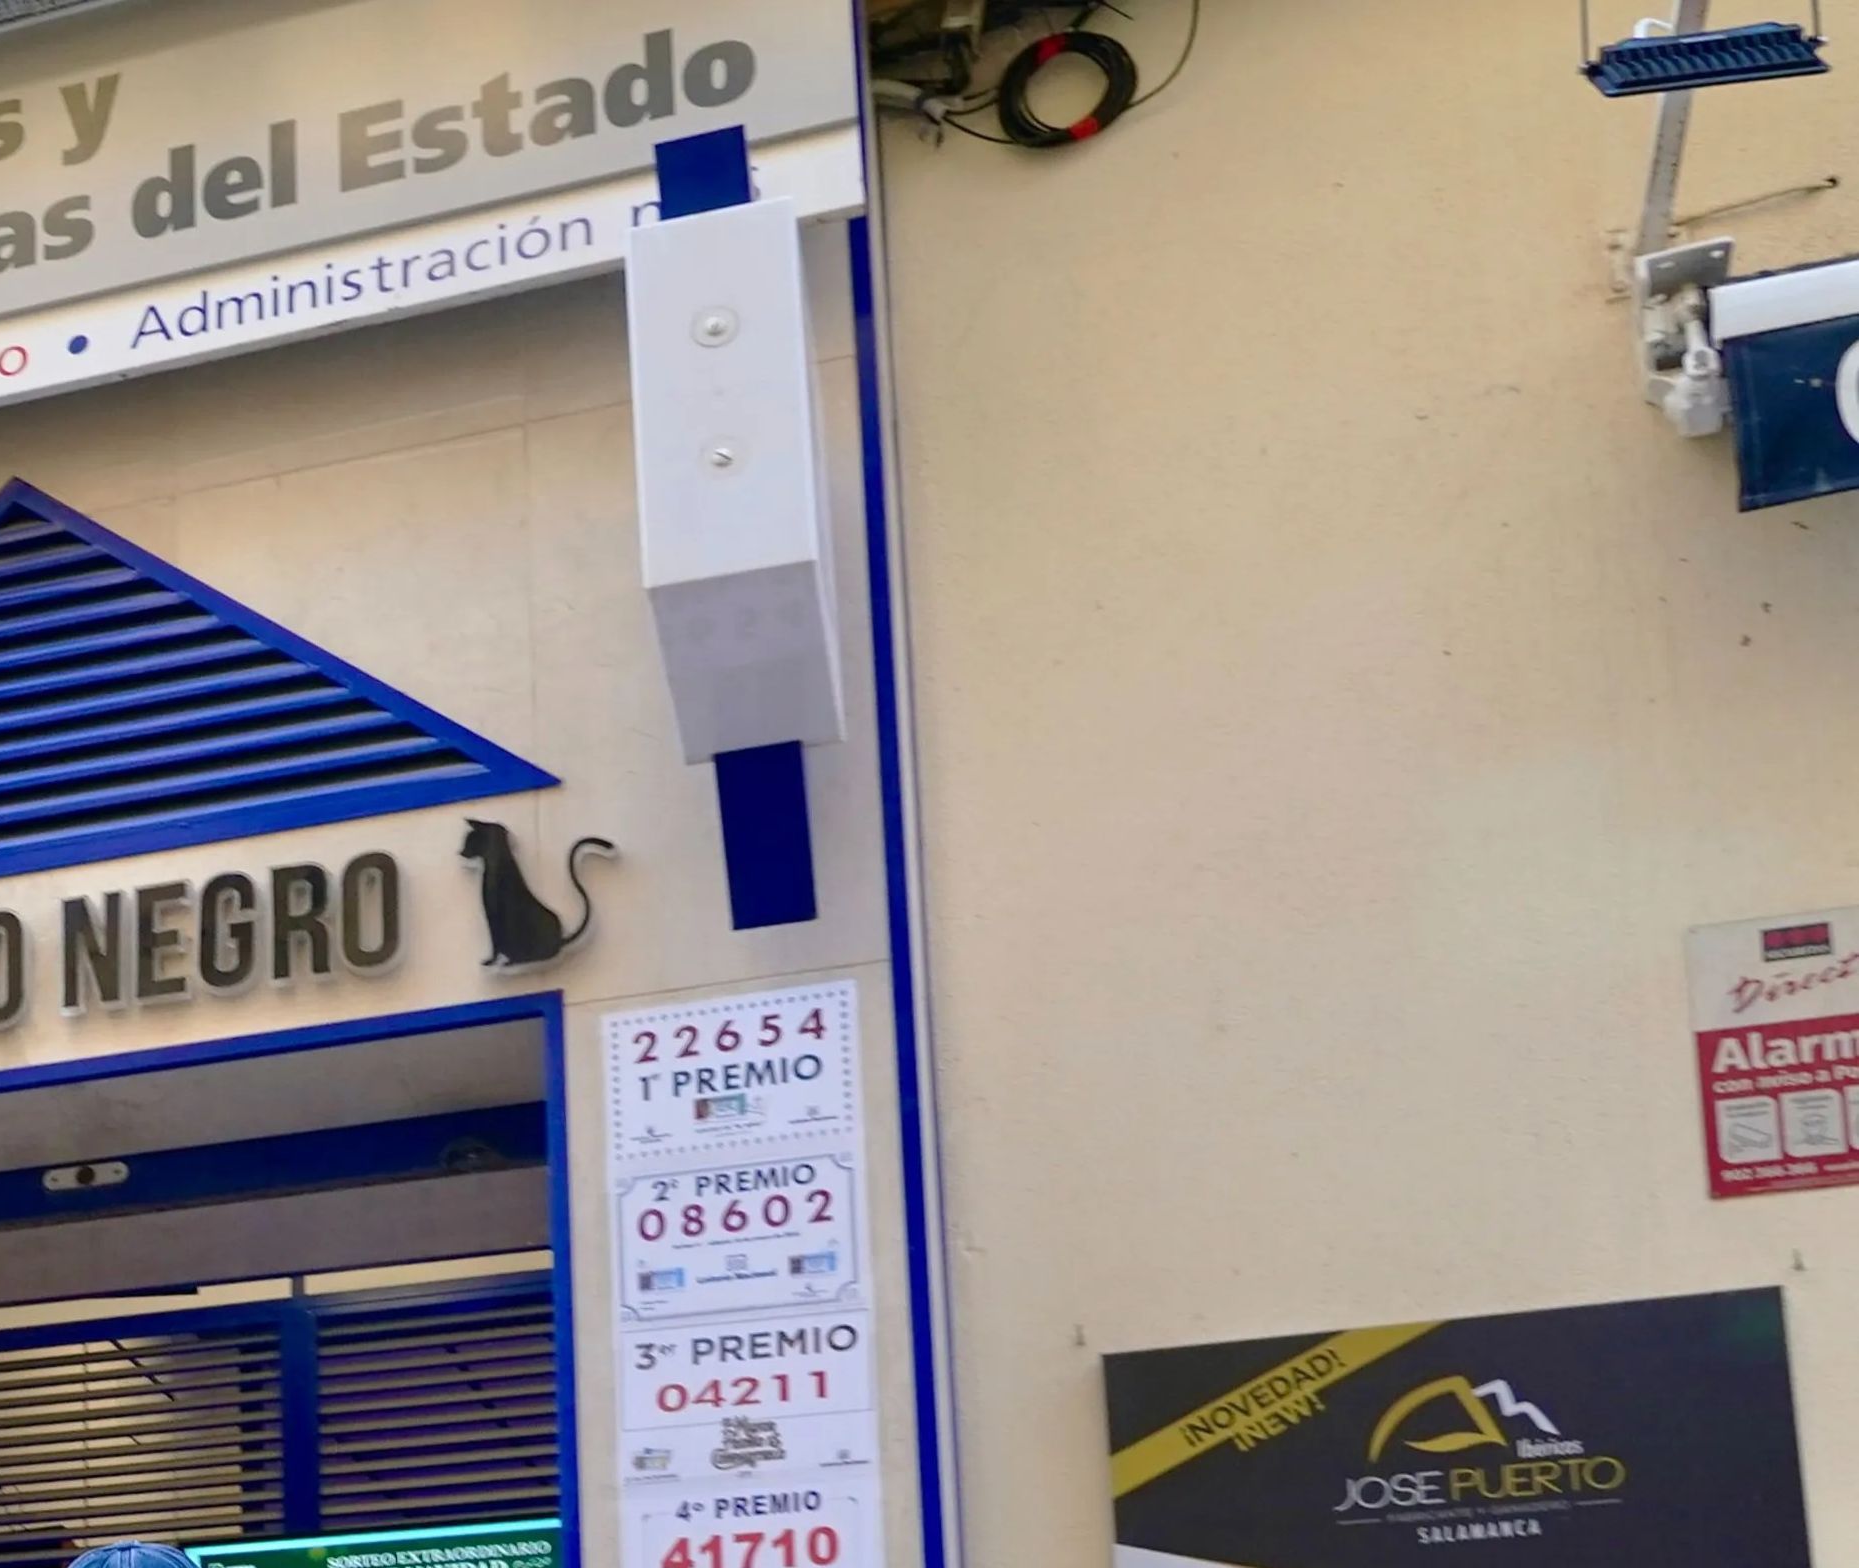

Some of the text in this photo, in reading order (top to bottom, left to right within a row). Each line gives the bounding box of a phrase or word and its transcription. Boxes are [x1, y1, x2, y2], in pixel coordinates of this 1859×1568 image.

[60, 72, 120, 166] y
[131, 119, 299, 239] del
[339, 28, 757, 193] Estado
[131, 215, 594, 349] Administración
[60, 849, 403, 1012] NEGRO
[633, 1007, 828, 1064] 22654
[671, 1054, 823, 1097] PREMIO
[694, 1164, 816, 1198] PREMIO
[637, 1189, 834, 1242] 08602
[691, 1324, 858, 1366] PREMIO
[655, 1370, 829, 1413] 04211
[1179, 1348, 1347, 1448] ¡NOVEDAD!
[714, 1490, 822, 1520] PREMIO
[1333, 1469, 1448, 1513] JOSE
[1449, 1455, 1627, 1501] PUERTO
[396, 1540, 553, 1566] EXTRAORDINARIO
[1416, 1518, 1543, 1545] SALAMANCA
